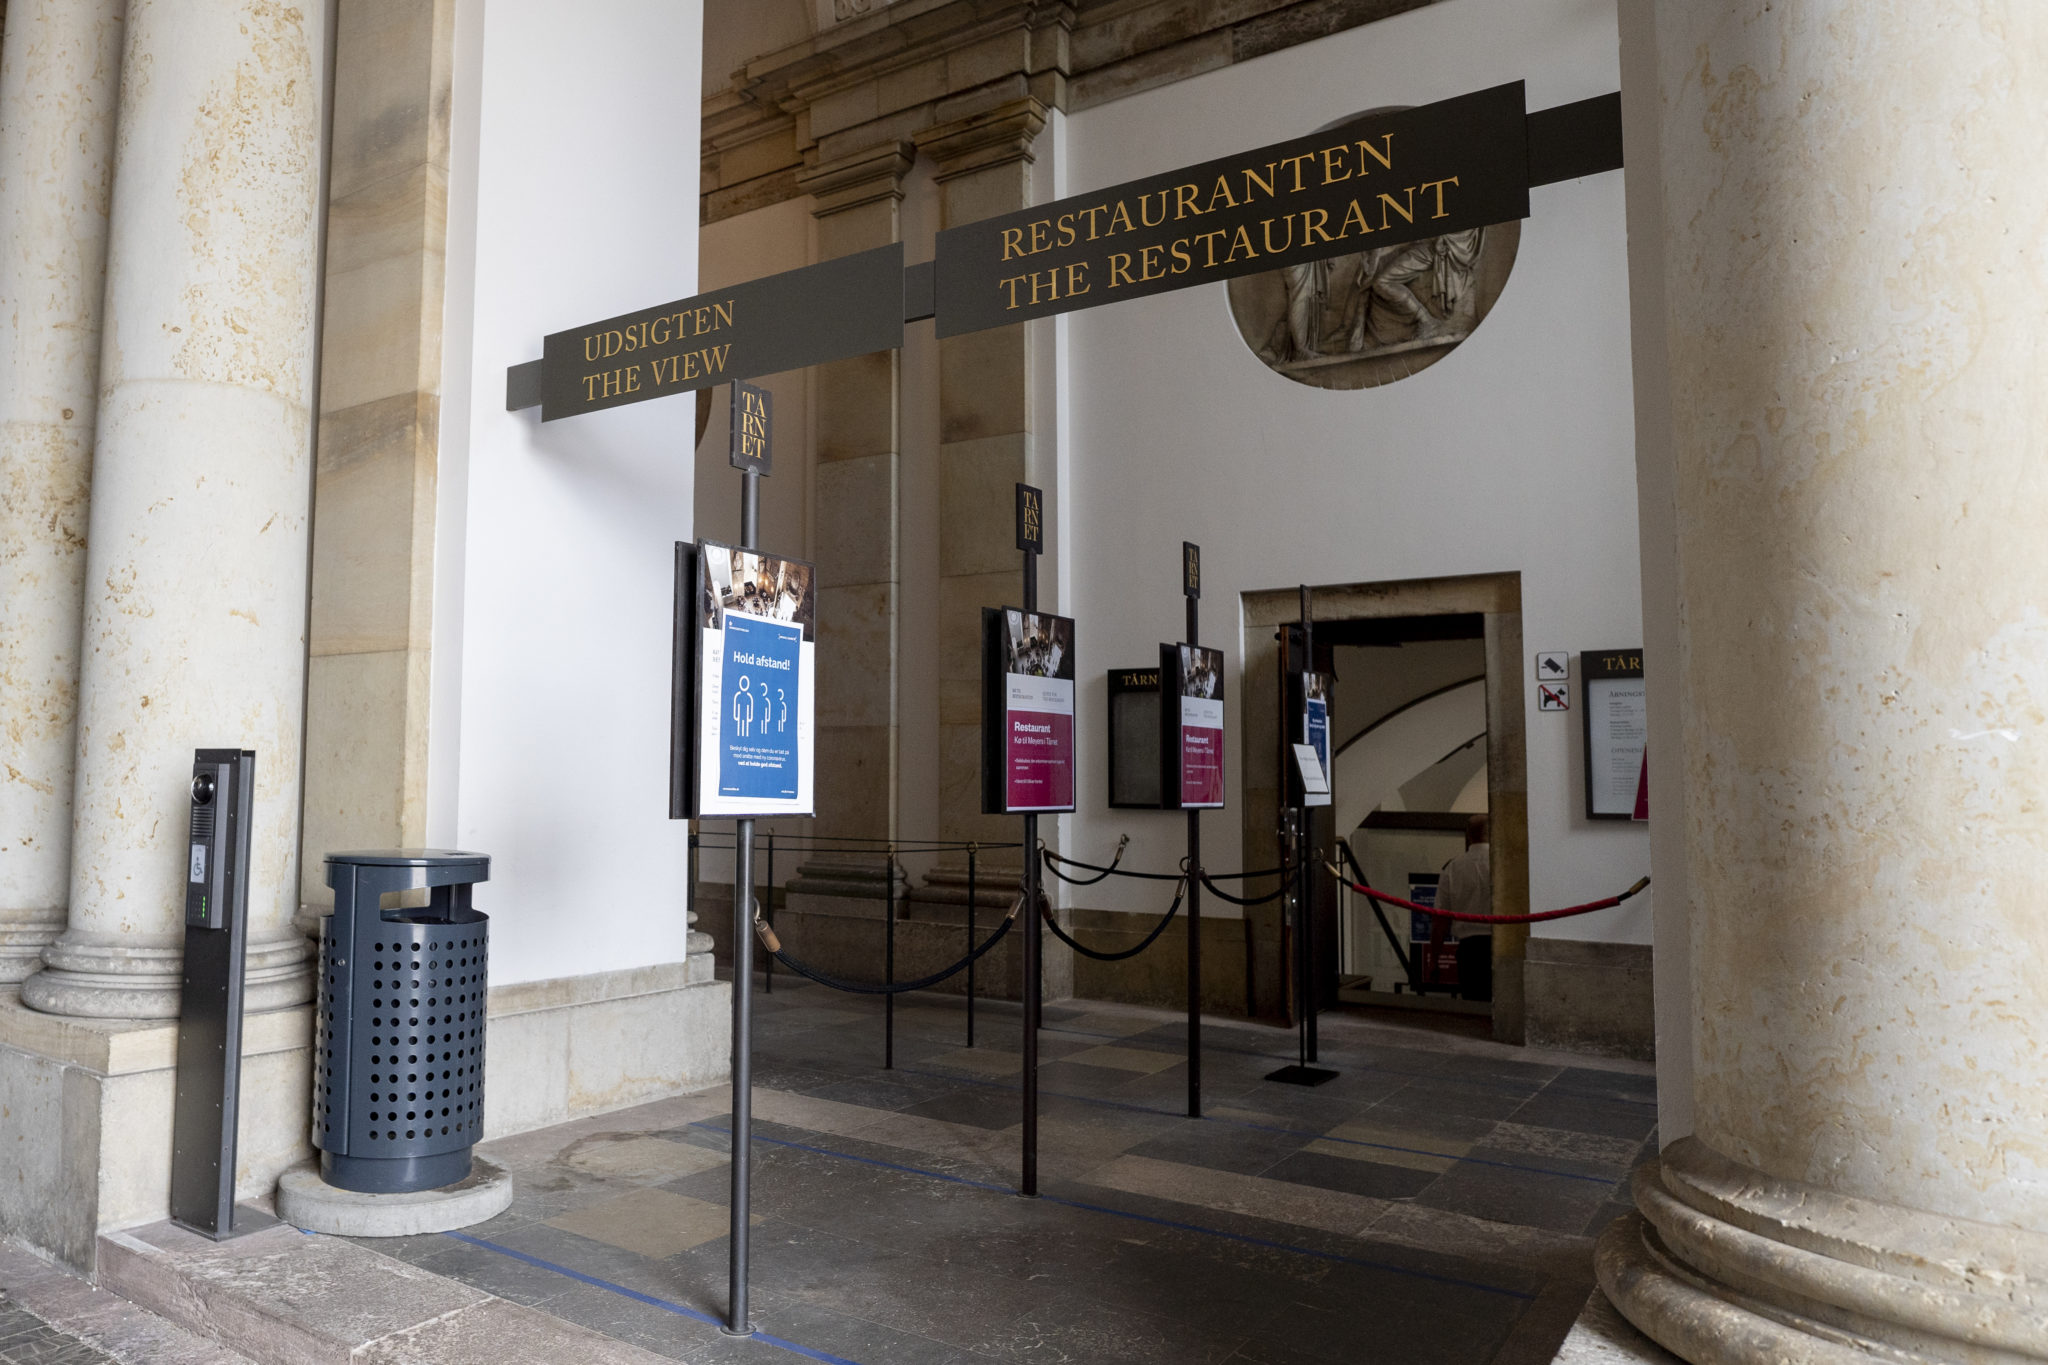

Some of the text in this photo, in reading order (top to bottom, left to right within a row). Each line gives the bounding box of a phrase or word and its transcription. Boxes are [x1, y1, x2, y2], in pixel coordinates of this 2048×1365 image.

[1001, 132, 1395, 262] RESTAURANTEN
[999, 175, 1460, 311] THE RESTAURANT
[584, 299, 735, 362] UDSIGTEN
[582, 343, 732, 401] THE VIEW
[733, 650, 755, 665] Hold
[755, 655, 790, 671] afstand!
[1014, 721, 1051, 733] Restaurant
